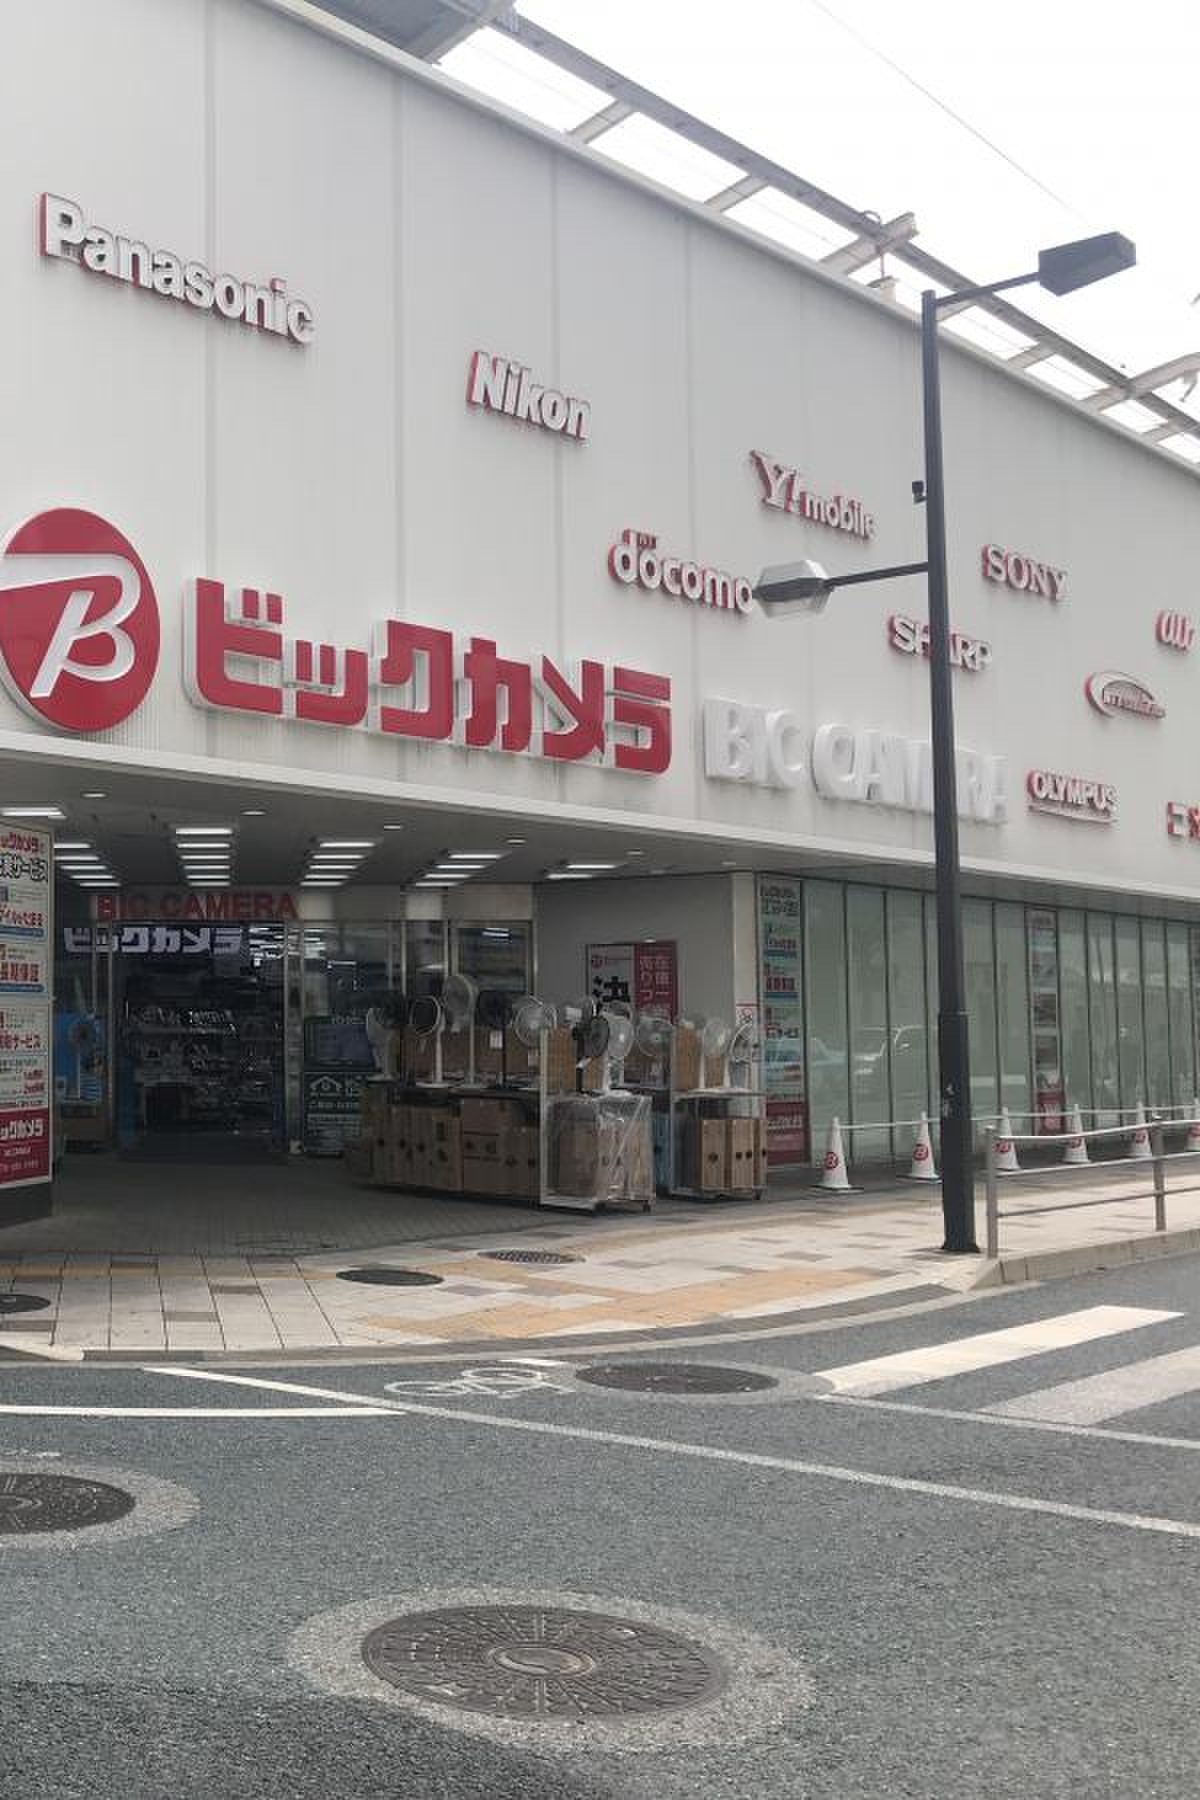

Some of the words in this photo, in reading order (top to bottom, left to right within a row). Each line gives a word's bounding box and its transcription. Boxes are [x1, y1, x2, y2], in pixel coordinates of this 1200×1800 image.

[38, 190, 314, 345] Panasonic
[466, 350, 591, 440] Nikon
[982, 543, 1067, 601] SONY
[184, 575, 673, 775] ビックカメラ
[703, 697, 803, 800] BIC
[1026, 768, 1119, 812] OLYMPUS
[63, 926, 243, 954] ビックカメラ
